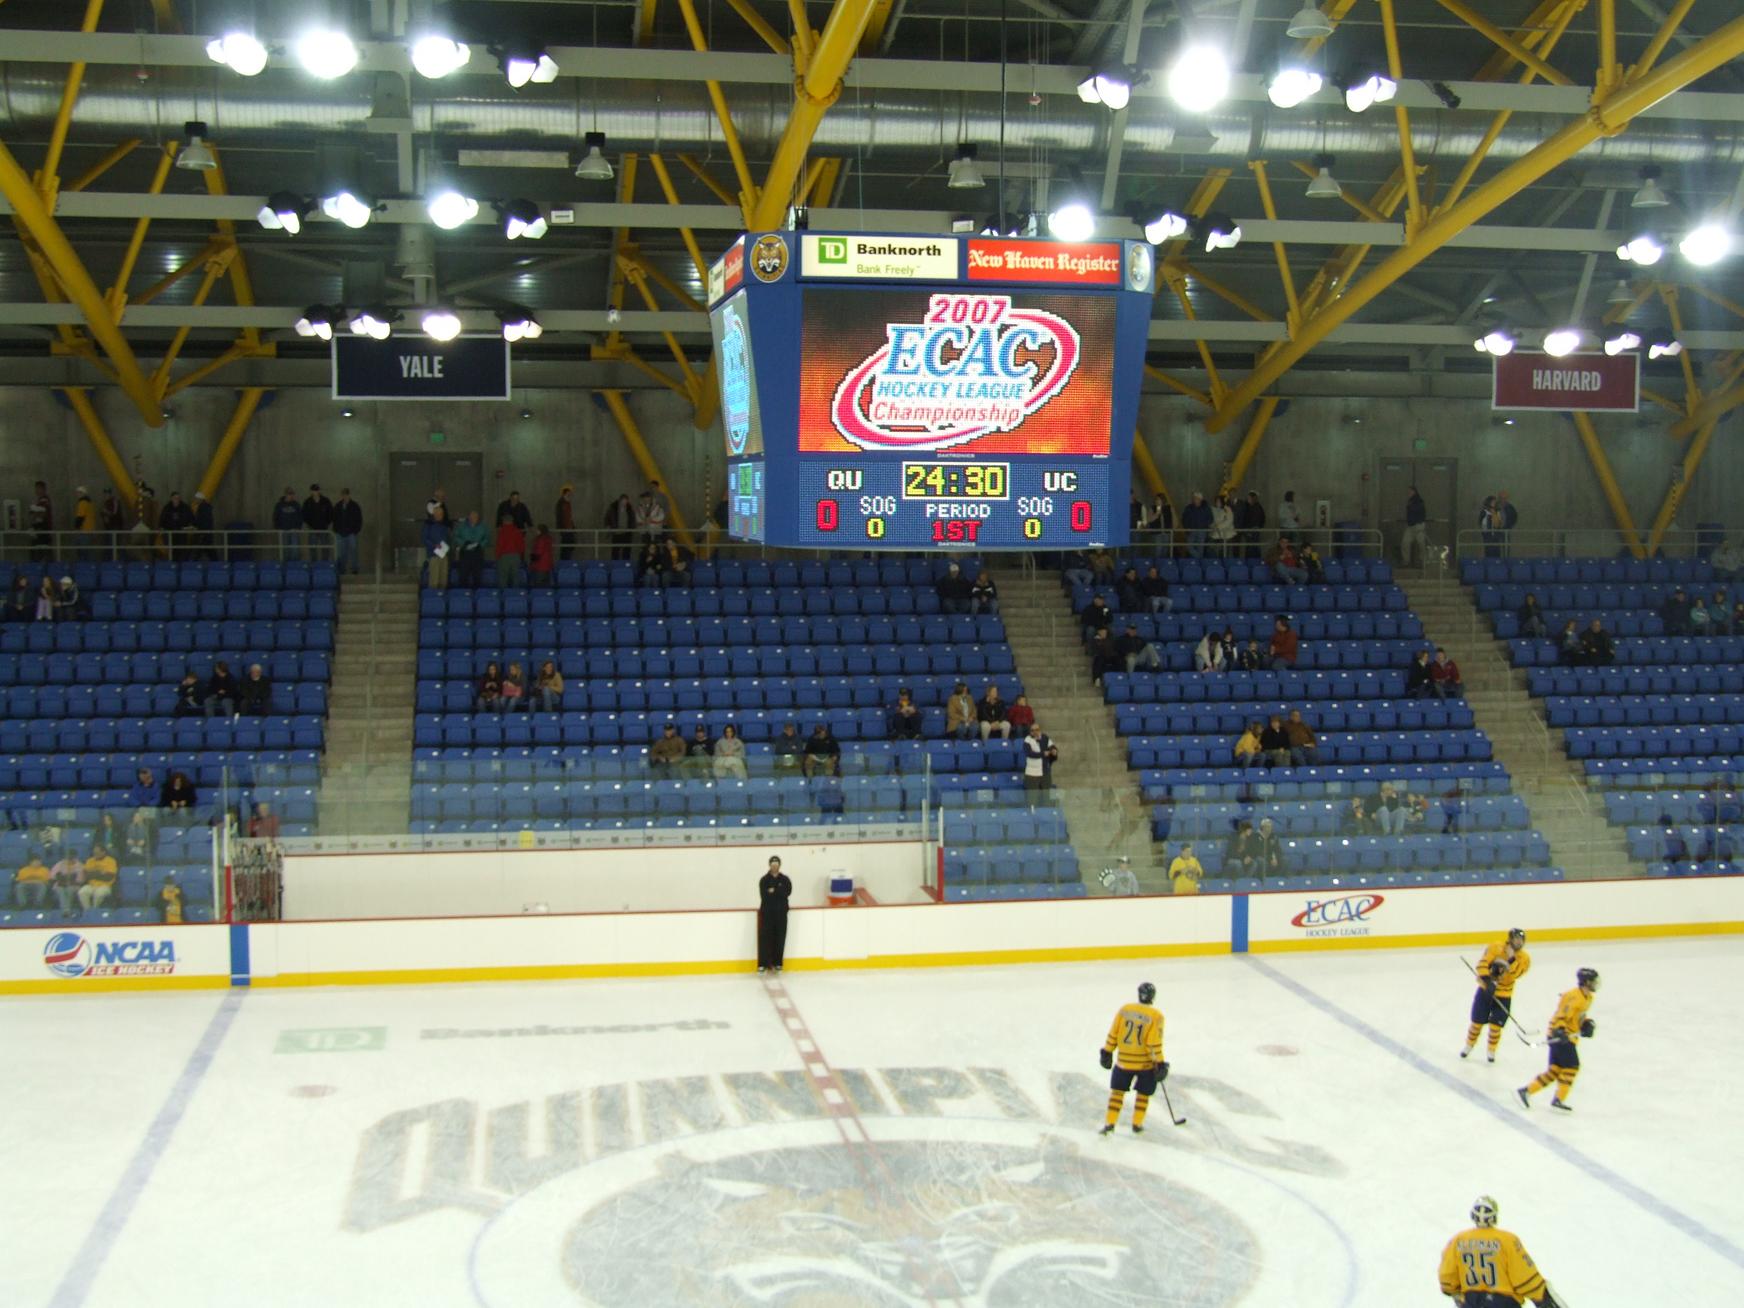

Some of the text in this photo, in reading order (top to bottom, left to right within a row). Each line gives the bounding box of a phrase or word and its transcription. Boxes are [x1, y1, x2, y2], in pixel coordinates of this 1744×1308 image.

[820, 241, 942, 260] TD Banknorth
[856, 264, 916, 277] Bank Freely
[968, 249, 1120, 275] New Haven Register
[931, 299, 1007, 324] 2007
[881, 326, 1041, 378] ECAC
[399, 355, 444, 378] YALE
[876, 381, 1026, 399] HOCKEY LEAGUE
[1532, 369, 1601, 391] HARVARD
[873, 401, 1021, 426] Championship
[827, 470, 863, 490] QU
[905, 466, 1004, 496] 24:30
[1043, 472, 1078, 492] UC
[816, 499, 839, 531] 0
[860, 495, 897, 515] SOG
[925, 503, 991, 518] PERIOD
[1017, 496, 1054, 516] SOG
[1071, 501, 1093, 532] 0
[866, 518, 885, 538] 0
[932, 520, 982, 541] 1ST
[1024, 518, 1042, 539] 0
[1305, 898, 1371, 923] ECAC
[1305, 927, 1370, 937] HOCKEY LEAGUE
[95, 940, 175, 965] NCAA
[92, 963, 173, 976] ICE HOCKEY
[419, 1019, 732, 1040] Banknorth
[1123, 1020, 1145, 1047] 21
[1462, 1251, 1497, 1288] 35
